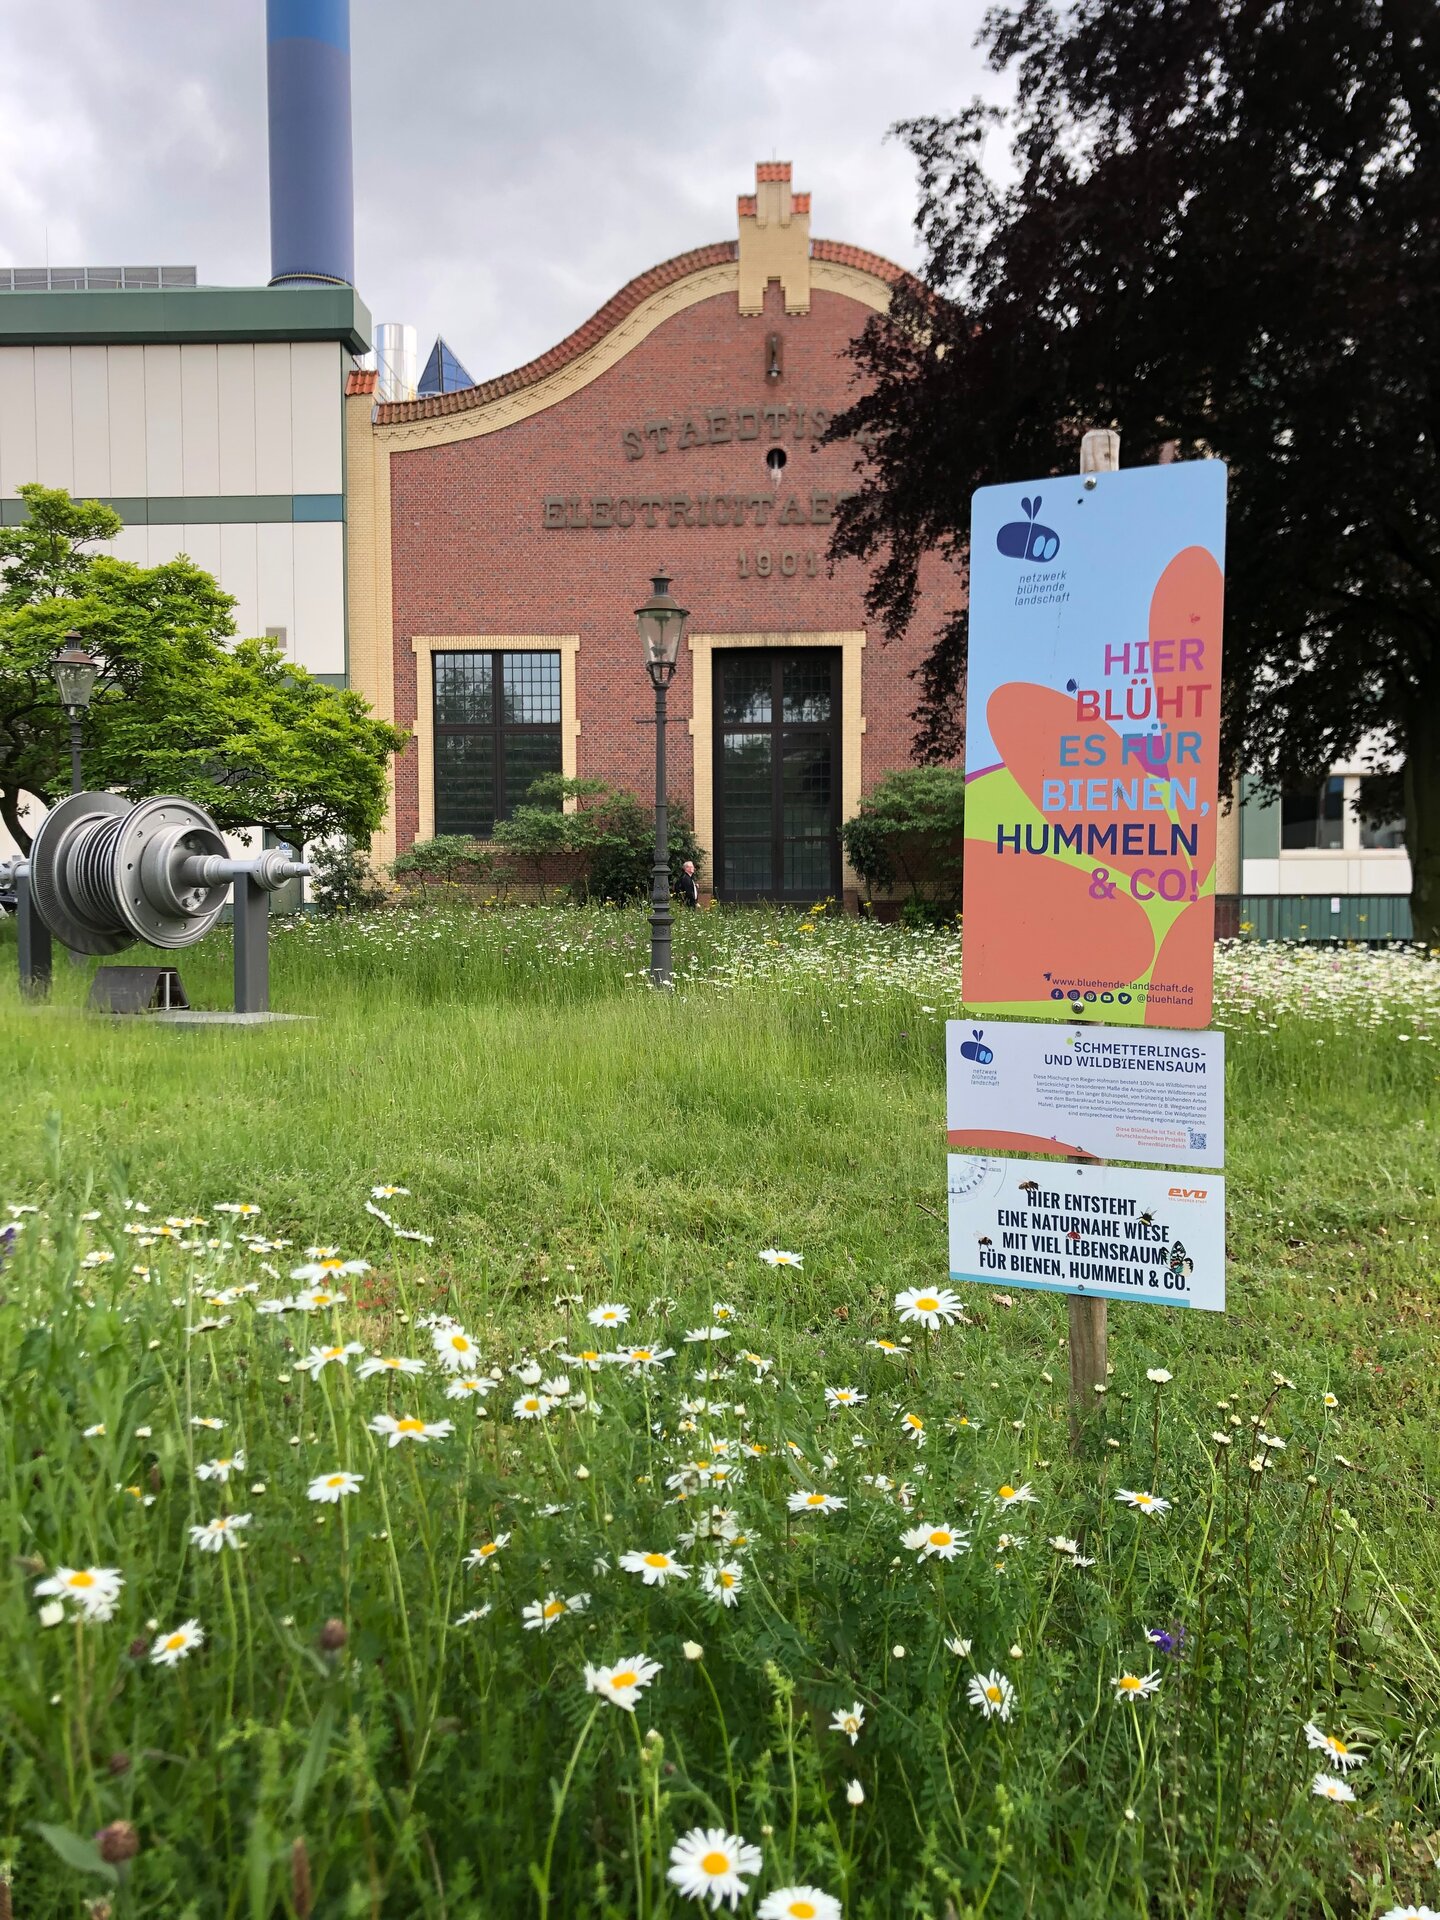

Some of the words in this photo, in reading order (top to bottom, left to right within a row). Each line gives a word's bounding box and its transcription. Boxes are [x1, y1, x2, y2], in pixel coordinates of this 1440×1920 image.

[738, 550, 817, 578] 1901
[1020, 570, 1067, 583] netzwerk
[1015, 592, 1070, 606] landschaft
[1017, 582, 1065, 595] blühende
[1104, 638, 1205, 676] HIER
[1076, 678, 1212, 722] BLÜHT
[1059, 734, 1107, 767] ES
[1122, 723, 1202, 766] FÜR
[1042, 777, 1211, 817] BIENEN,
[997, 823, 1198, 856] HUMMELN
[1088, 868, 1116, 900] &
[1130, 868, 1198, 902] CO!
[1052, 978, 1194, 994] www.bluehende-landschaft.de
[1137, 994, 1194, 1006] @bluehland
[1044, 1054, 1073, 1066] UND
[1076, 1056, 1206, 1074] WILDBIENENSAUM
[1074, 1042, 1206, 1059] SCHMETTERLINGS-
[1027, 1190, 1061, 1210] HIER
[1064, 1193, 1137, 1216] ENTSTEHT
[1168, 1188, 1208, 1199] evo
[998, 1209, 1028, 1230] EINE
[1032, 1214, 1120, 1238] NATURNAHE
[1124, 1223, 1170, 1243] WIESE
[1002, 1232, 1028, 1250] MIT
[1031, 1235, 1061, 1255] VIEL
[1065, 1238, 1166, 1266] LEBENSRAUM
[979, 1248, 1006, 1270] FÜR
[1010, 1256, 1065, 1279] BIENEN,
[1069, 1261, 1144, 1286] HUMMELN
[1148, 1270, 1159, 1288] &
[1163, 1272, 1191, 1292] CO.
